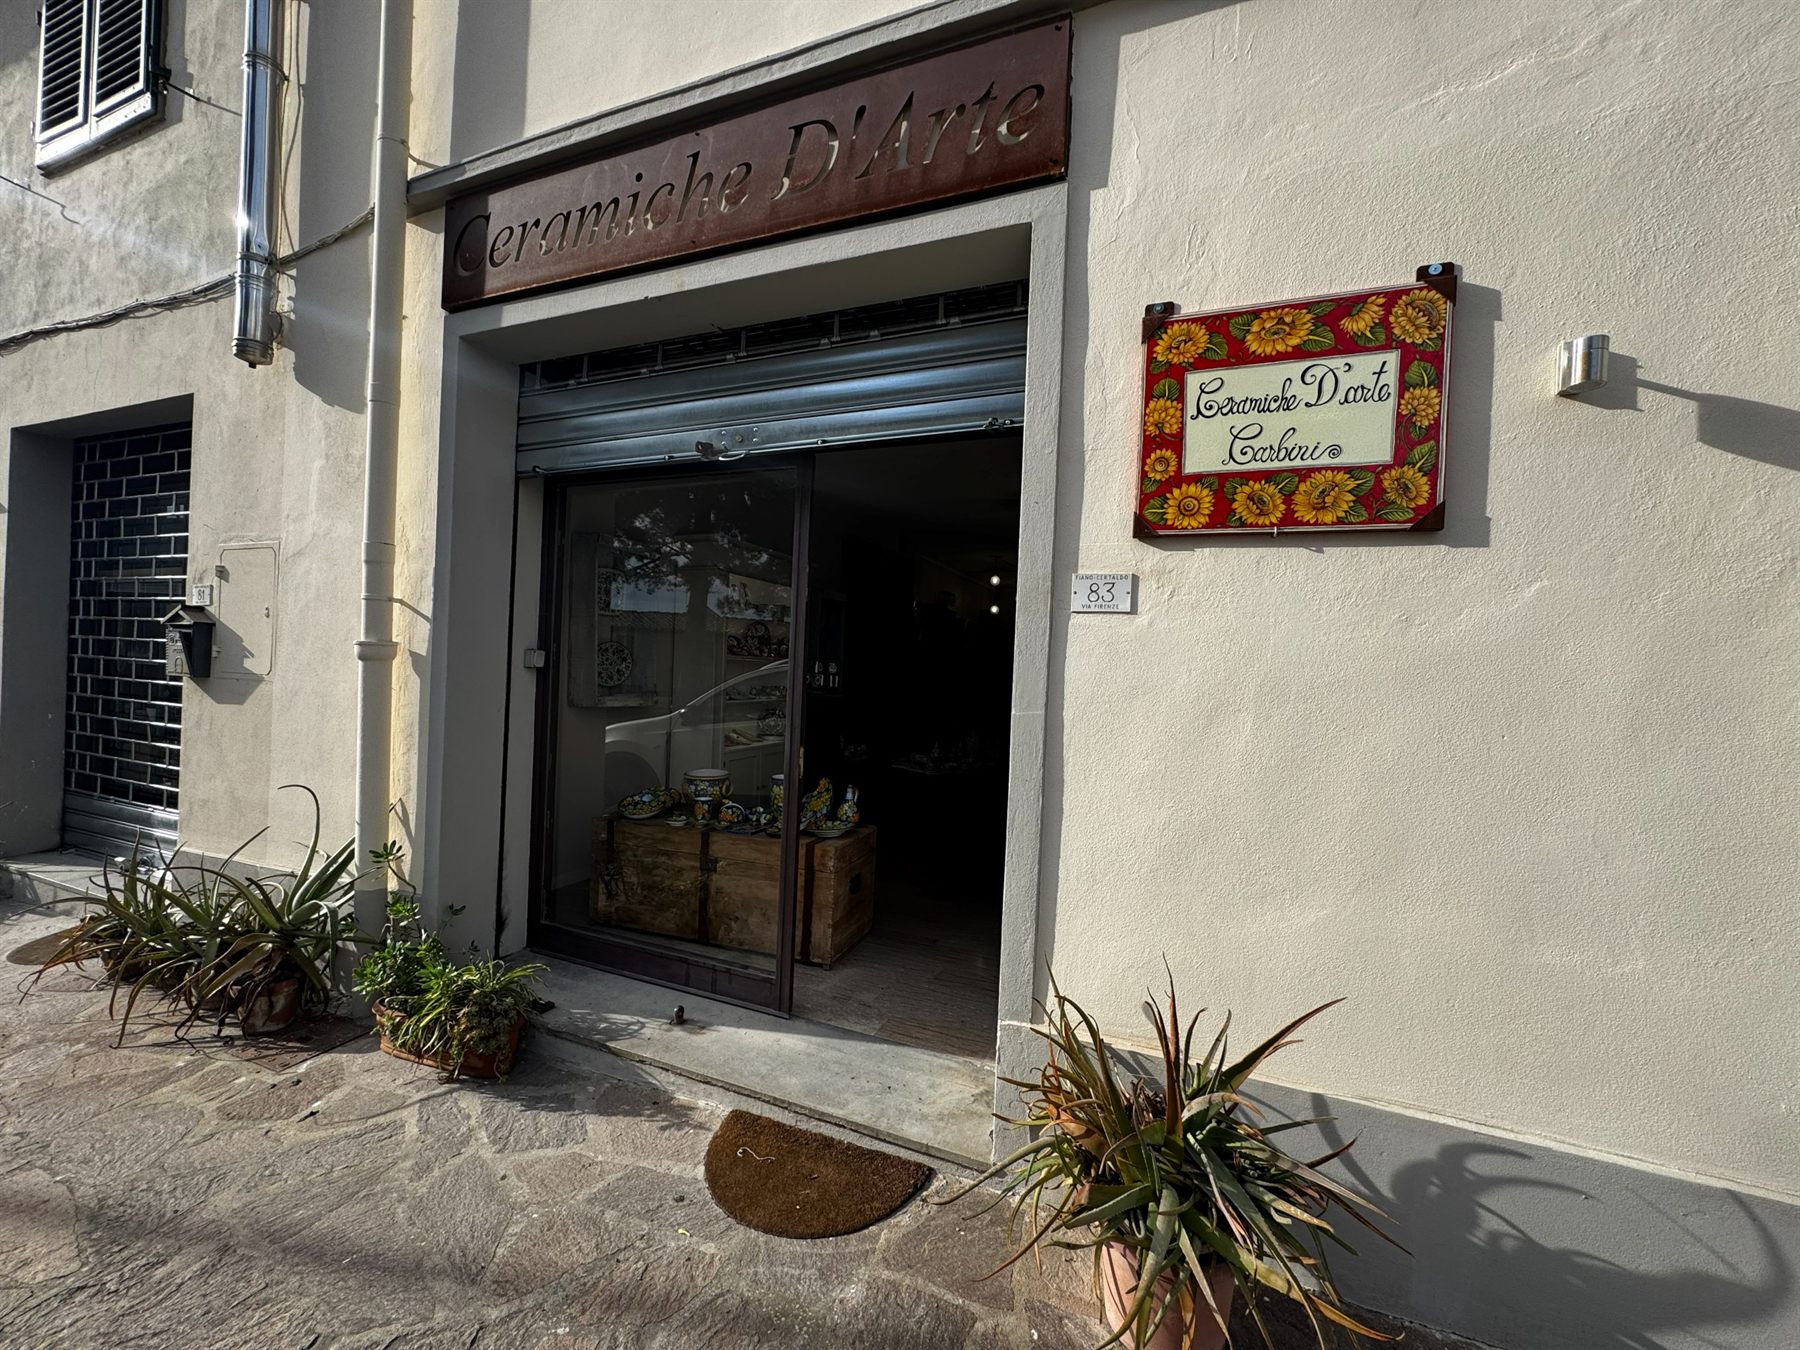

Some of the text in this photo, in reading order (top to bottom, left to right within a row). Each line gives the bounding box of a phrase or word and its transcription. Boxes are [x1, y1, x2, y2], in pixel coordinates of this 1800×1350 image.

[452, 80, 1046, 278] Ceramiche D'Arte
[1190, 360, 1391, 421] Ceramiche D'arte
[1221, 423, 1342, 466] Carbini
[197, 588, 205, 601] 81
[1087, 582, 1116, 603] 83
